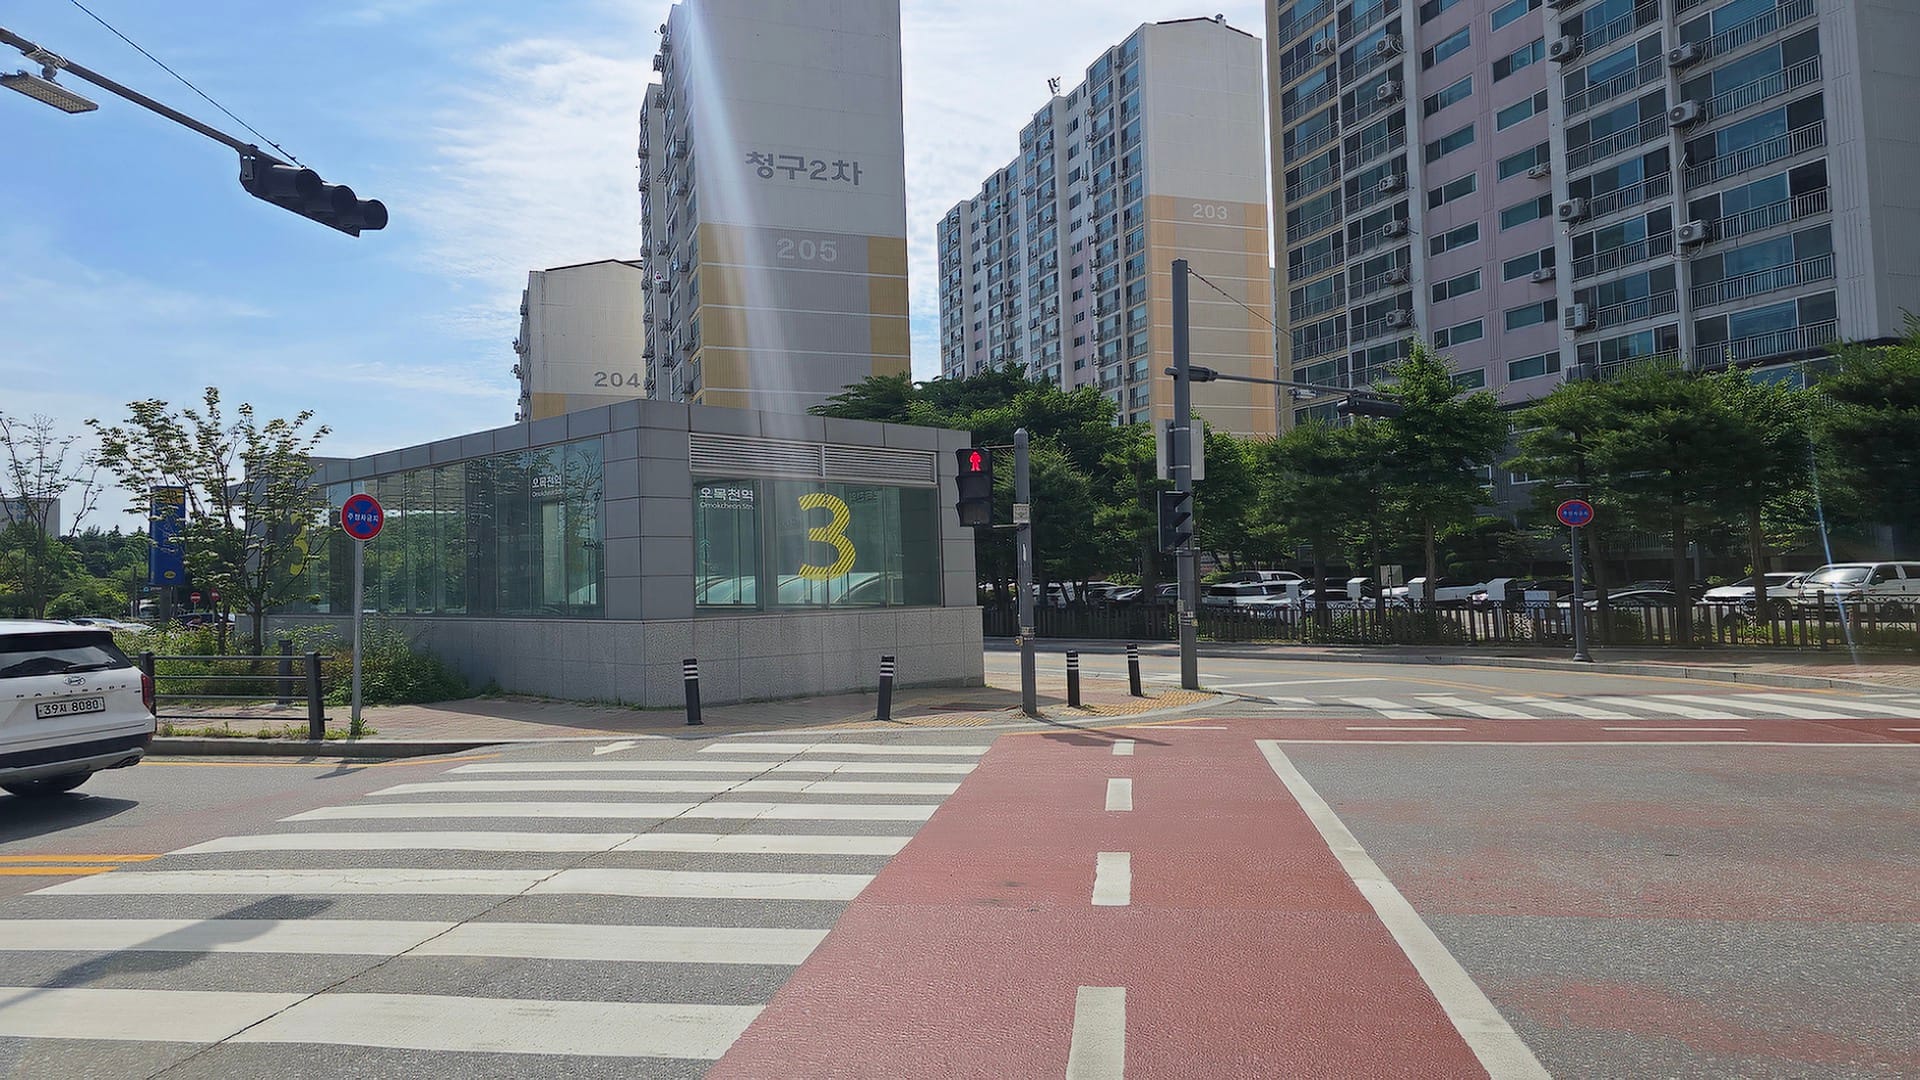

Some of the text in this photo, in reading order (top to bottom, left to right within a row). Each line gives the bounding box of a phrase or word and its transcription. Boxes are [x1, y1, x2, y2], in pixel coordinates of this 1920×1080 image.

[745, 151, 863, 186] 청구2차
[1192, 203, 1228, 220] 203
[776, 238, 838, 262] 205
[594, 371, 641, 388] 204
[699, 487, 754, 502] 오목천역
[798, 492, 857, 580] 3
[71, 700, 99, 712] 8080
